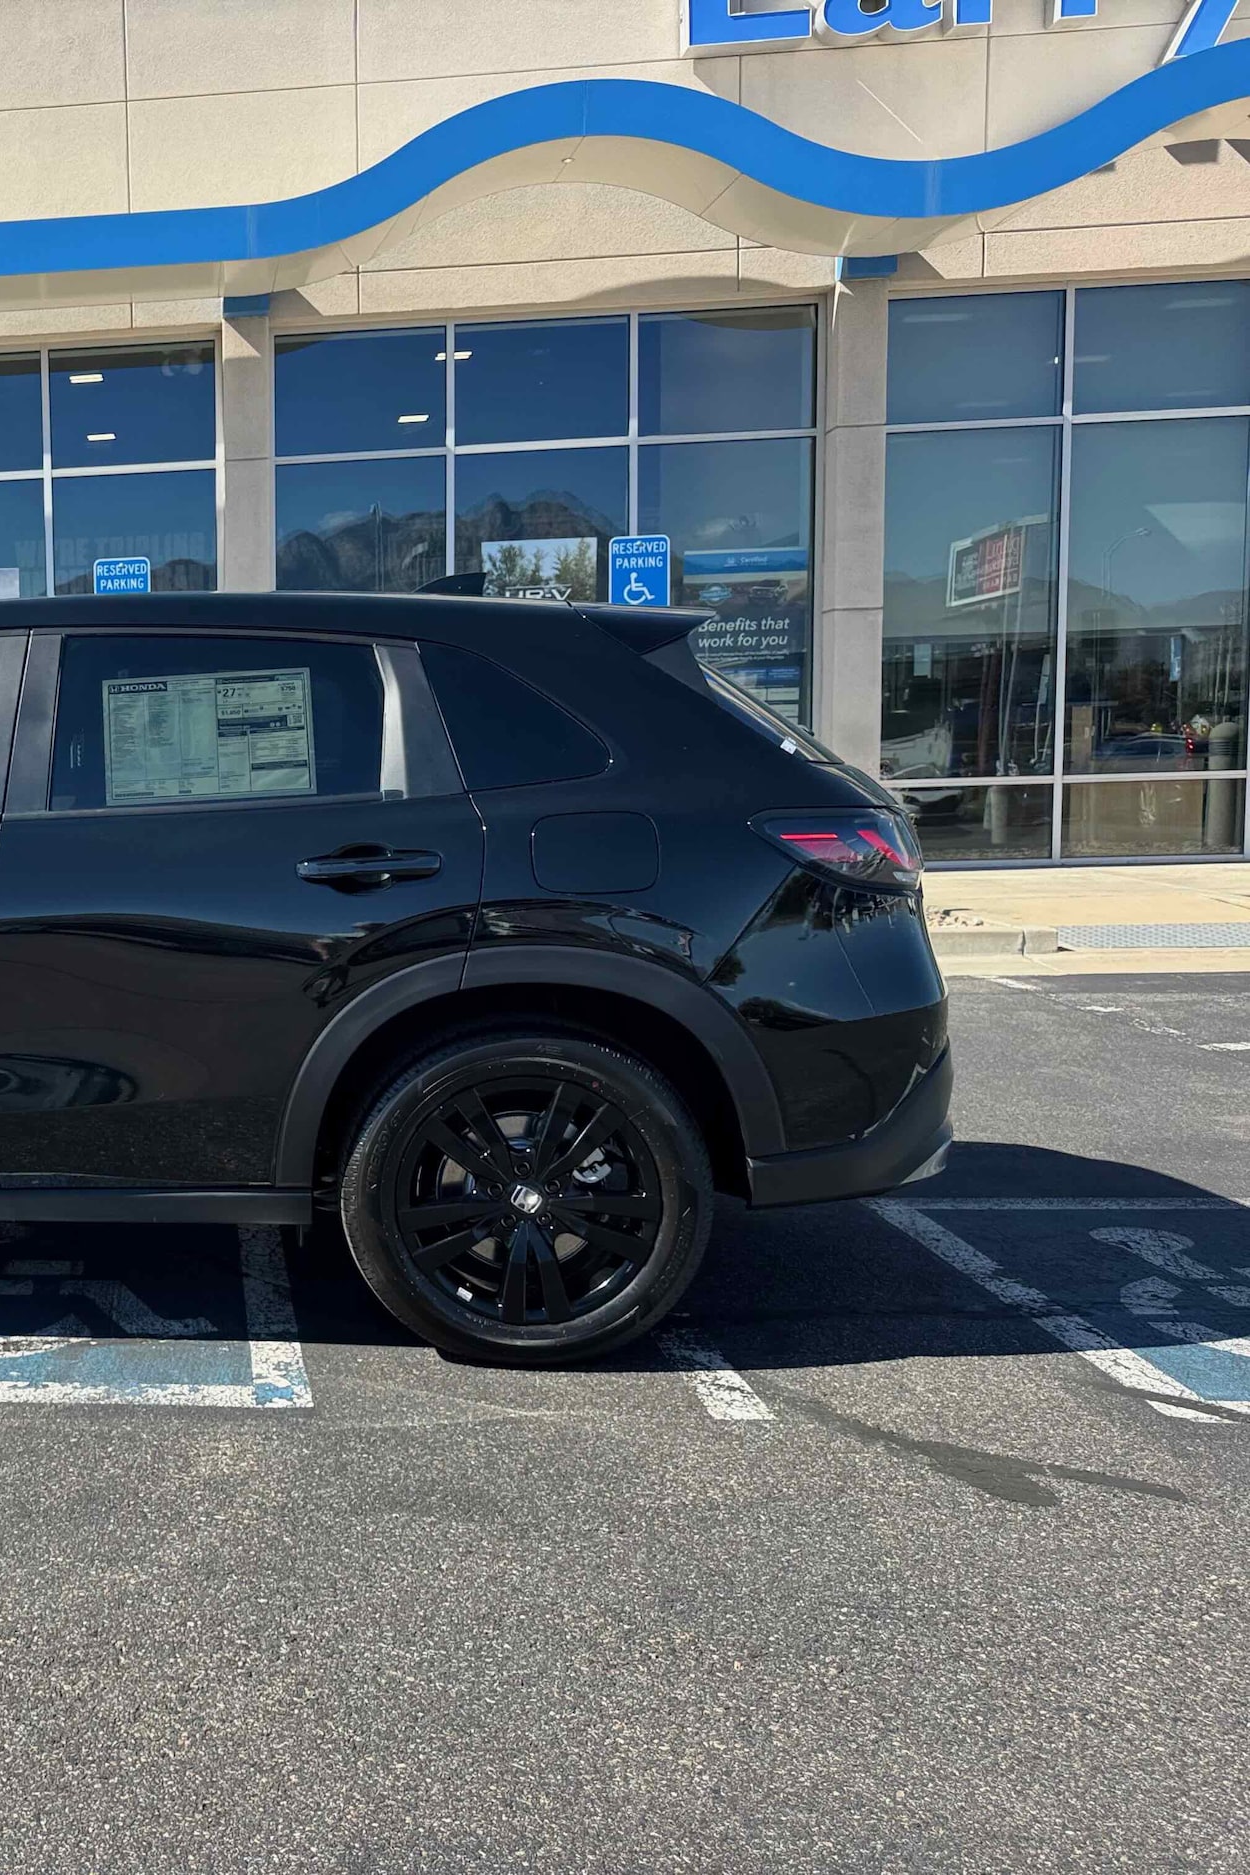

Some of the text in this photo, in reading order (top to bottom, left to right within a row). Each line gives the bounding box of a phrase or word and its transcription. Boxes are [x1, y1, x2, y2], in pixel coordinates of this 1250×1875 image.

[612, 541, 667, 555] RESERVED
[615, 556, 663, 569] PARKING
[97, 563, 147, 576] RESERVED
[100, 578, 145, 590] PARKING
[699, 616, 790, 632] Benefits that
[698, 633, 789, 649] work for you
[121, 683, 166, 692] HONDA
[222, 688, 236, 698] 27
